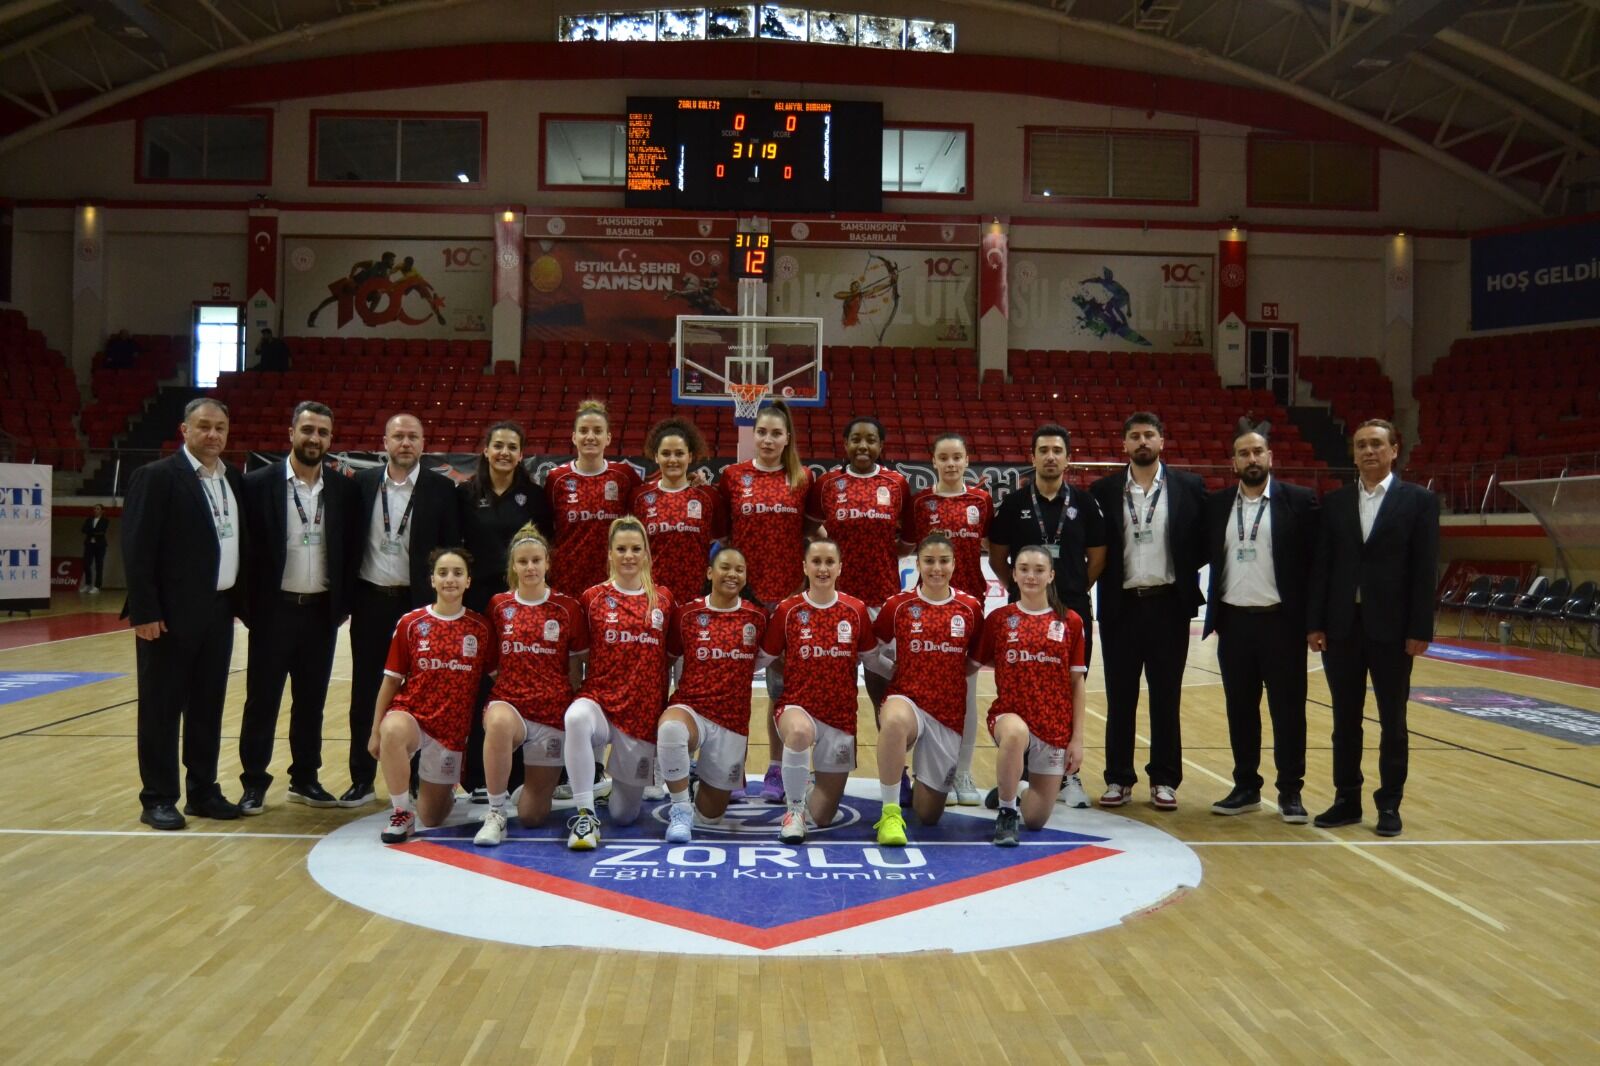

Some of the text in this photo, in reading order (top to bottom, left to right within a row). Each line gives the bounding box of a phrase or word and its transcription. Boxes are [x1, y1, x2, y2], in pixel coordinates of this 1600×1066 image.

[734, 115, 745, 130] 0
[786, 116, 796, 131] 0
[716, 164, 724, 177] 0
[783, 166, 792, 179] 0
[746, 251, 765, 273] 12
[1487, 257, 1600, 292] HOŞ GELDİ
[582, 274, 675, 291] SAMSUN
[1263, 305, 1278, 317] B1
[594, 844, 927, 868] ZORLU
[589, 867, 935, 881] Eğitim Kurumları
